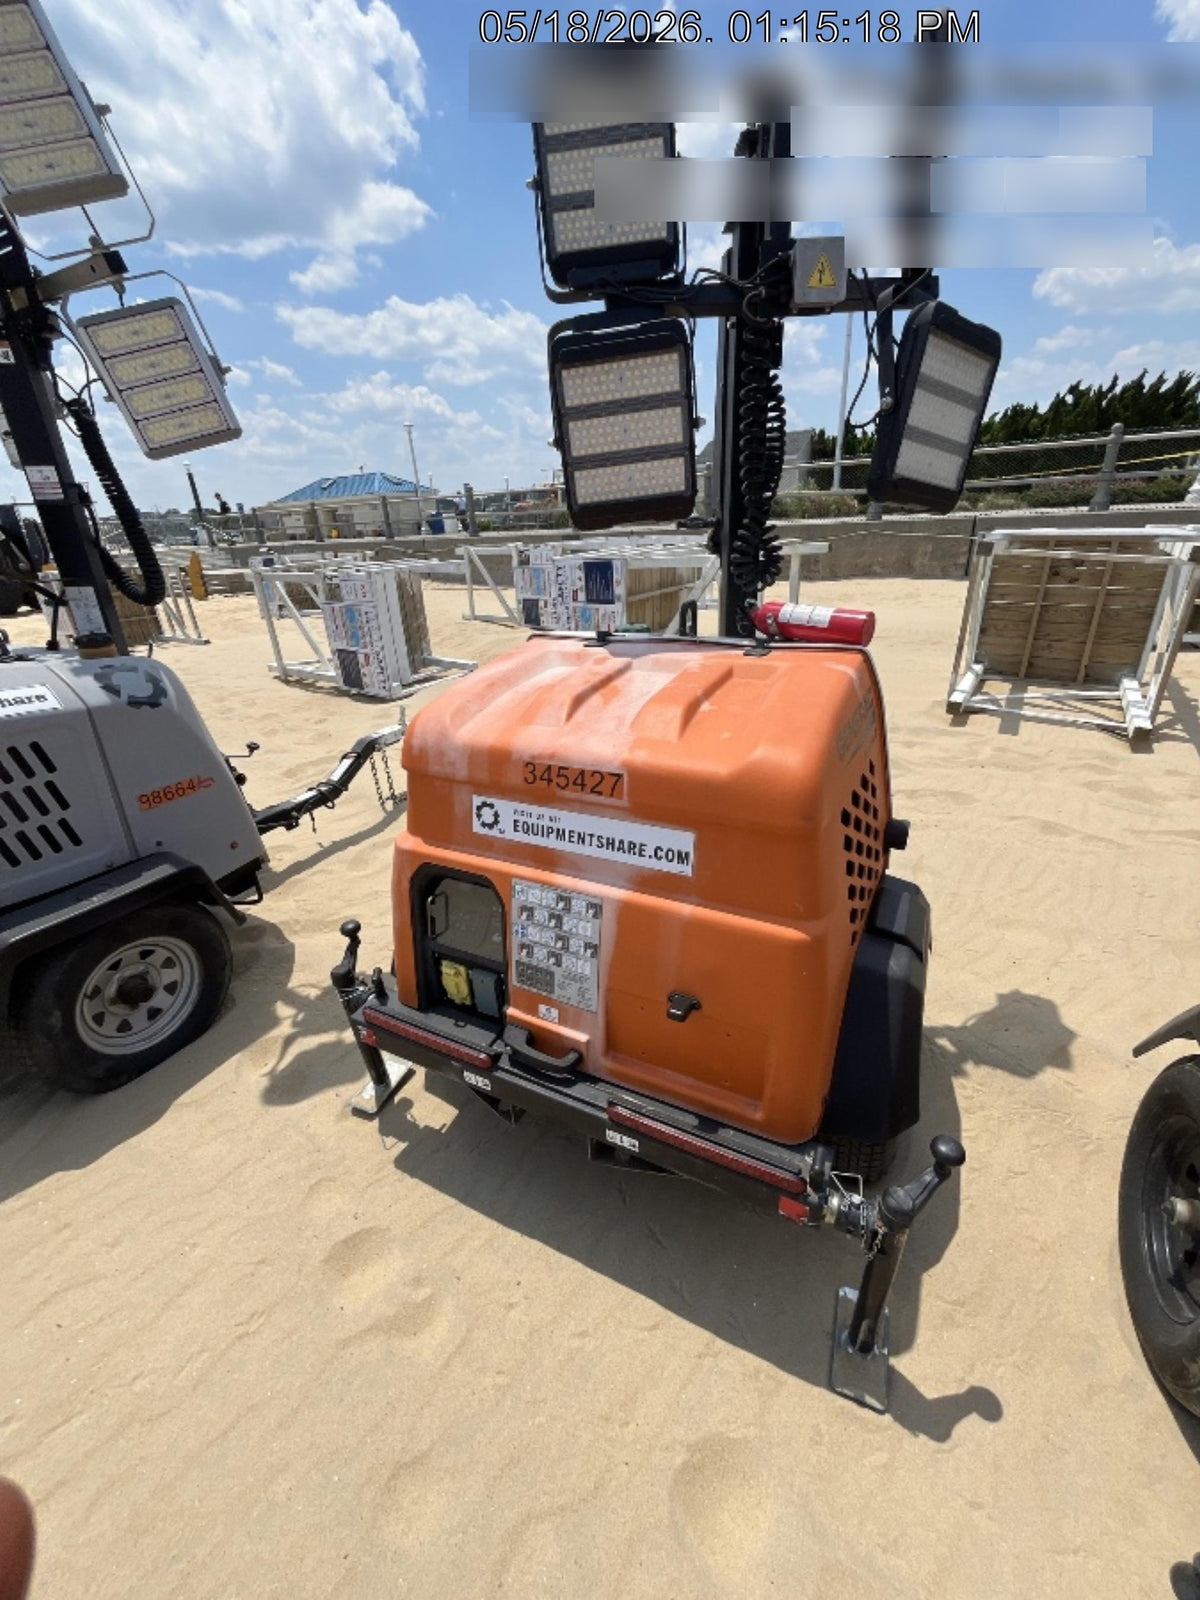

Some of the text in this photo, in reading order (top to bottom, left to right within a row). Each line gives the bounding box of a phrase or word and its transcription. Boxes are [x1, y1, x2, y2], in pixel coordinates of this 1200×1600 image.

[138, 778, 197, 809] 98664
[523, 762, 624, 797] 345427
[512, 818, 691, 867] EQUIPMENTSHARE.COM
